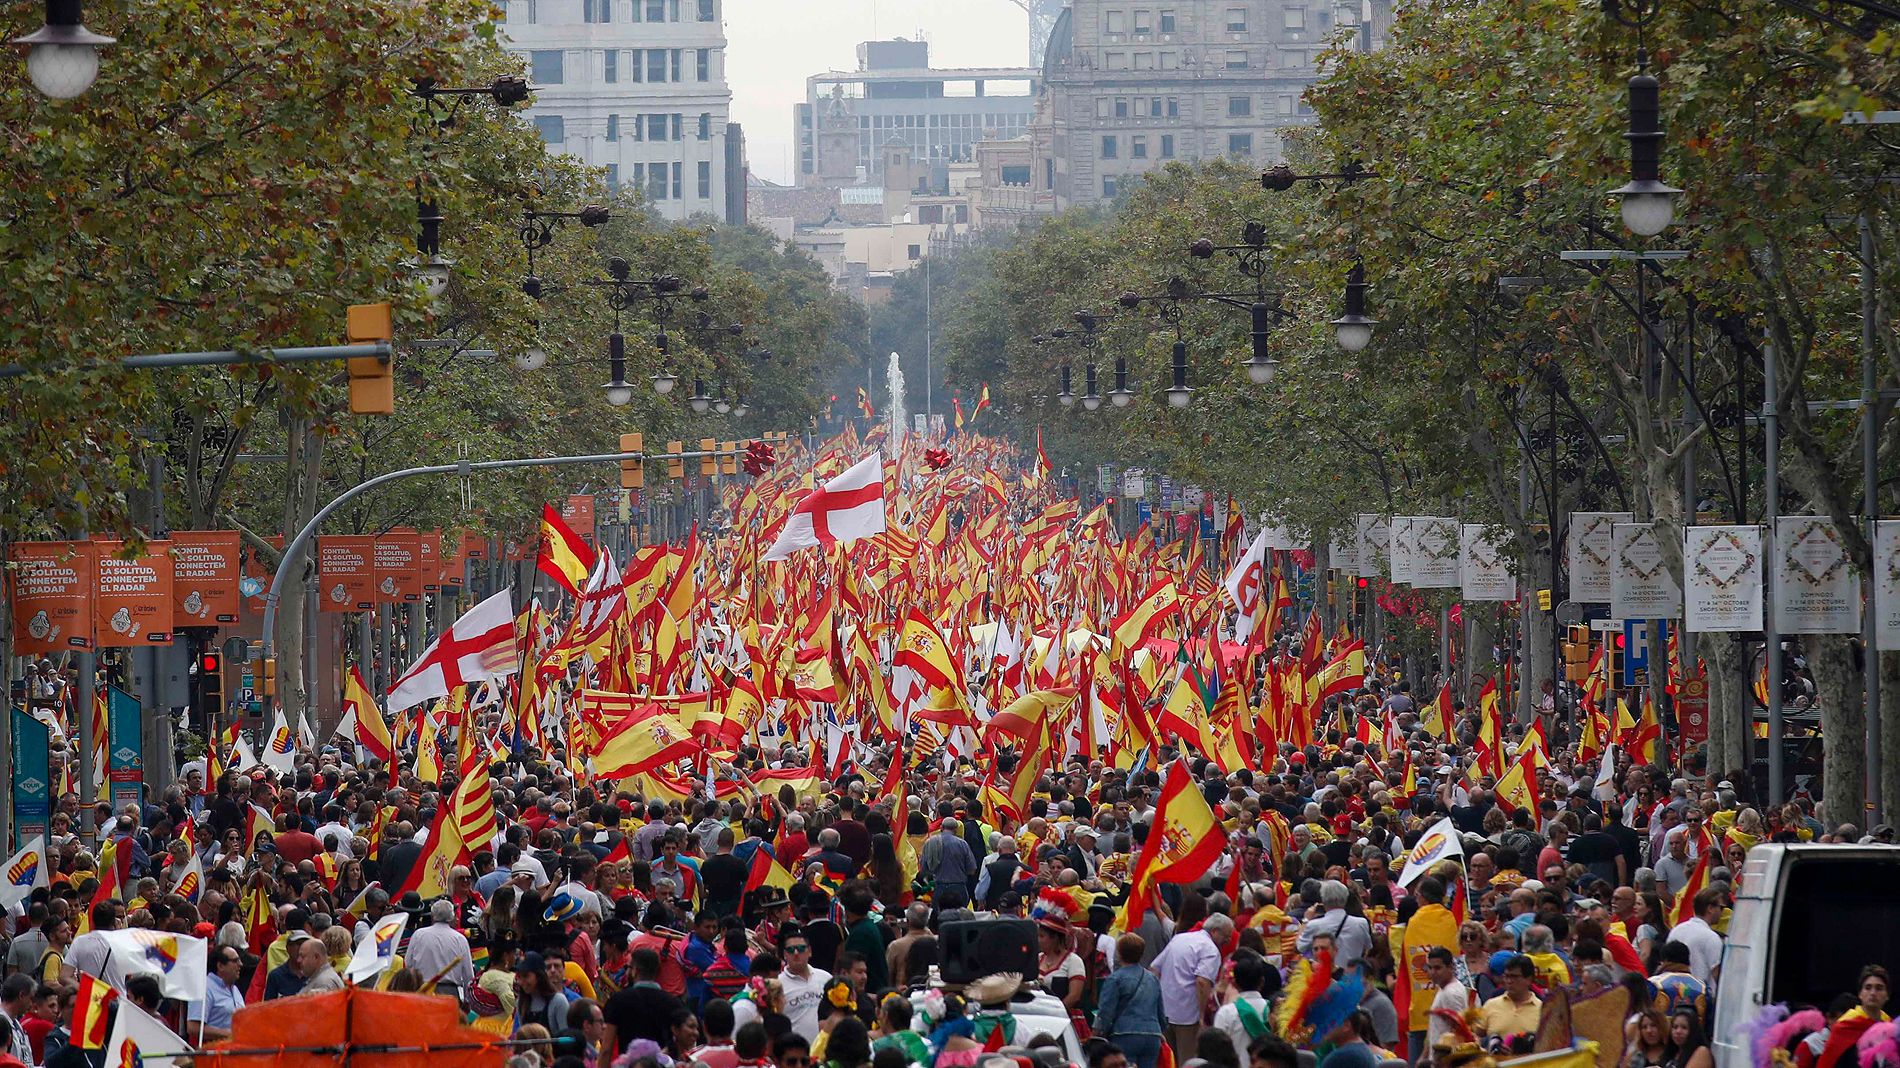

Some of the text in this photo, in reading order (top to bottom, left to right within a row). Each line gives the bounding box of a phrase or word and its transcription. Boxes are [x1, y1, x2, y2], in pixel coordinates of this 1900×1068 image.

[30, 568, 76, 577] SOLITUD,
[16, 577, 78, 586] CONNECTEM
[29, 586, 65, 594] RADAR
[245, 690, 252, 700] P
